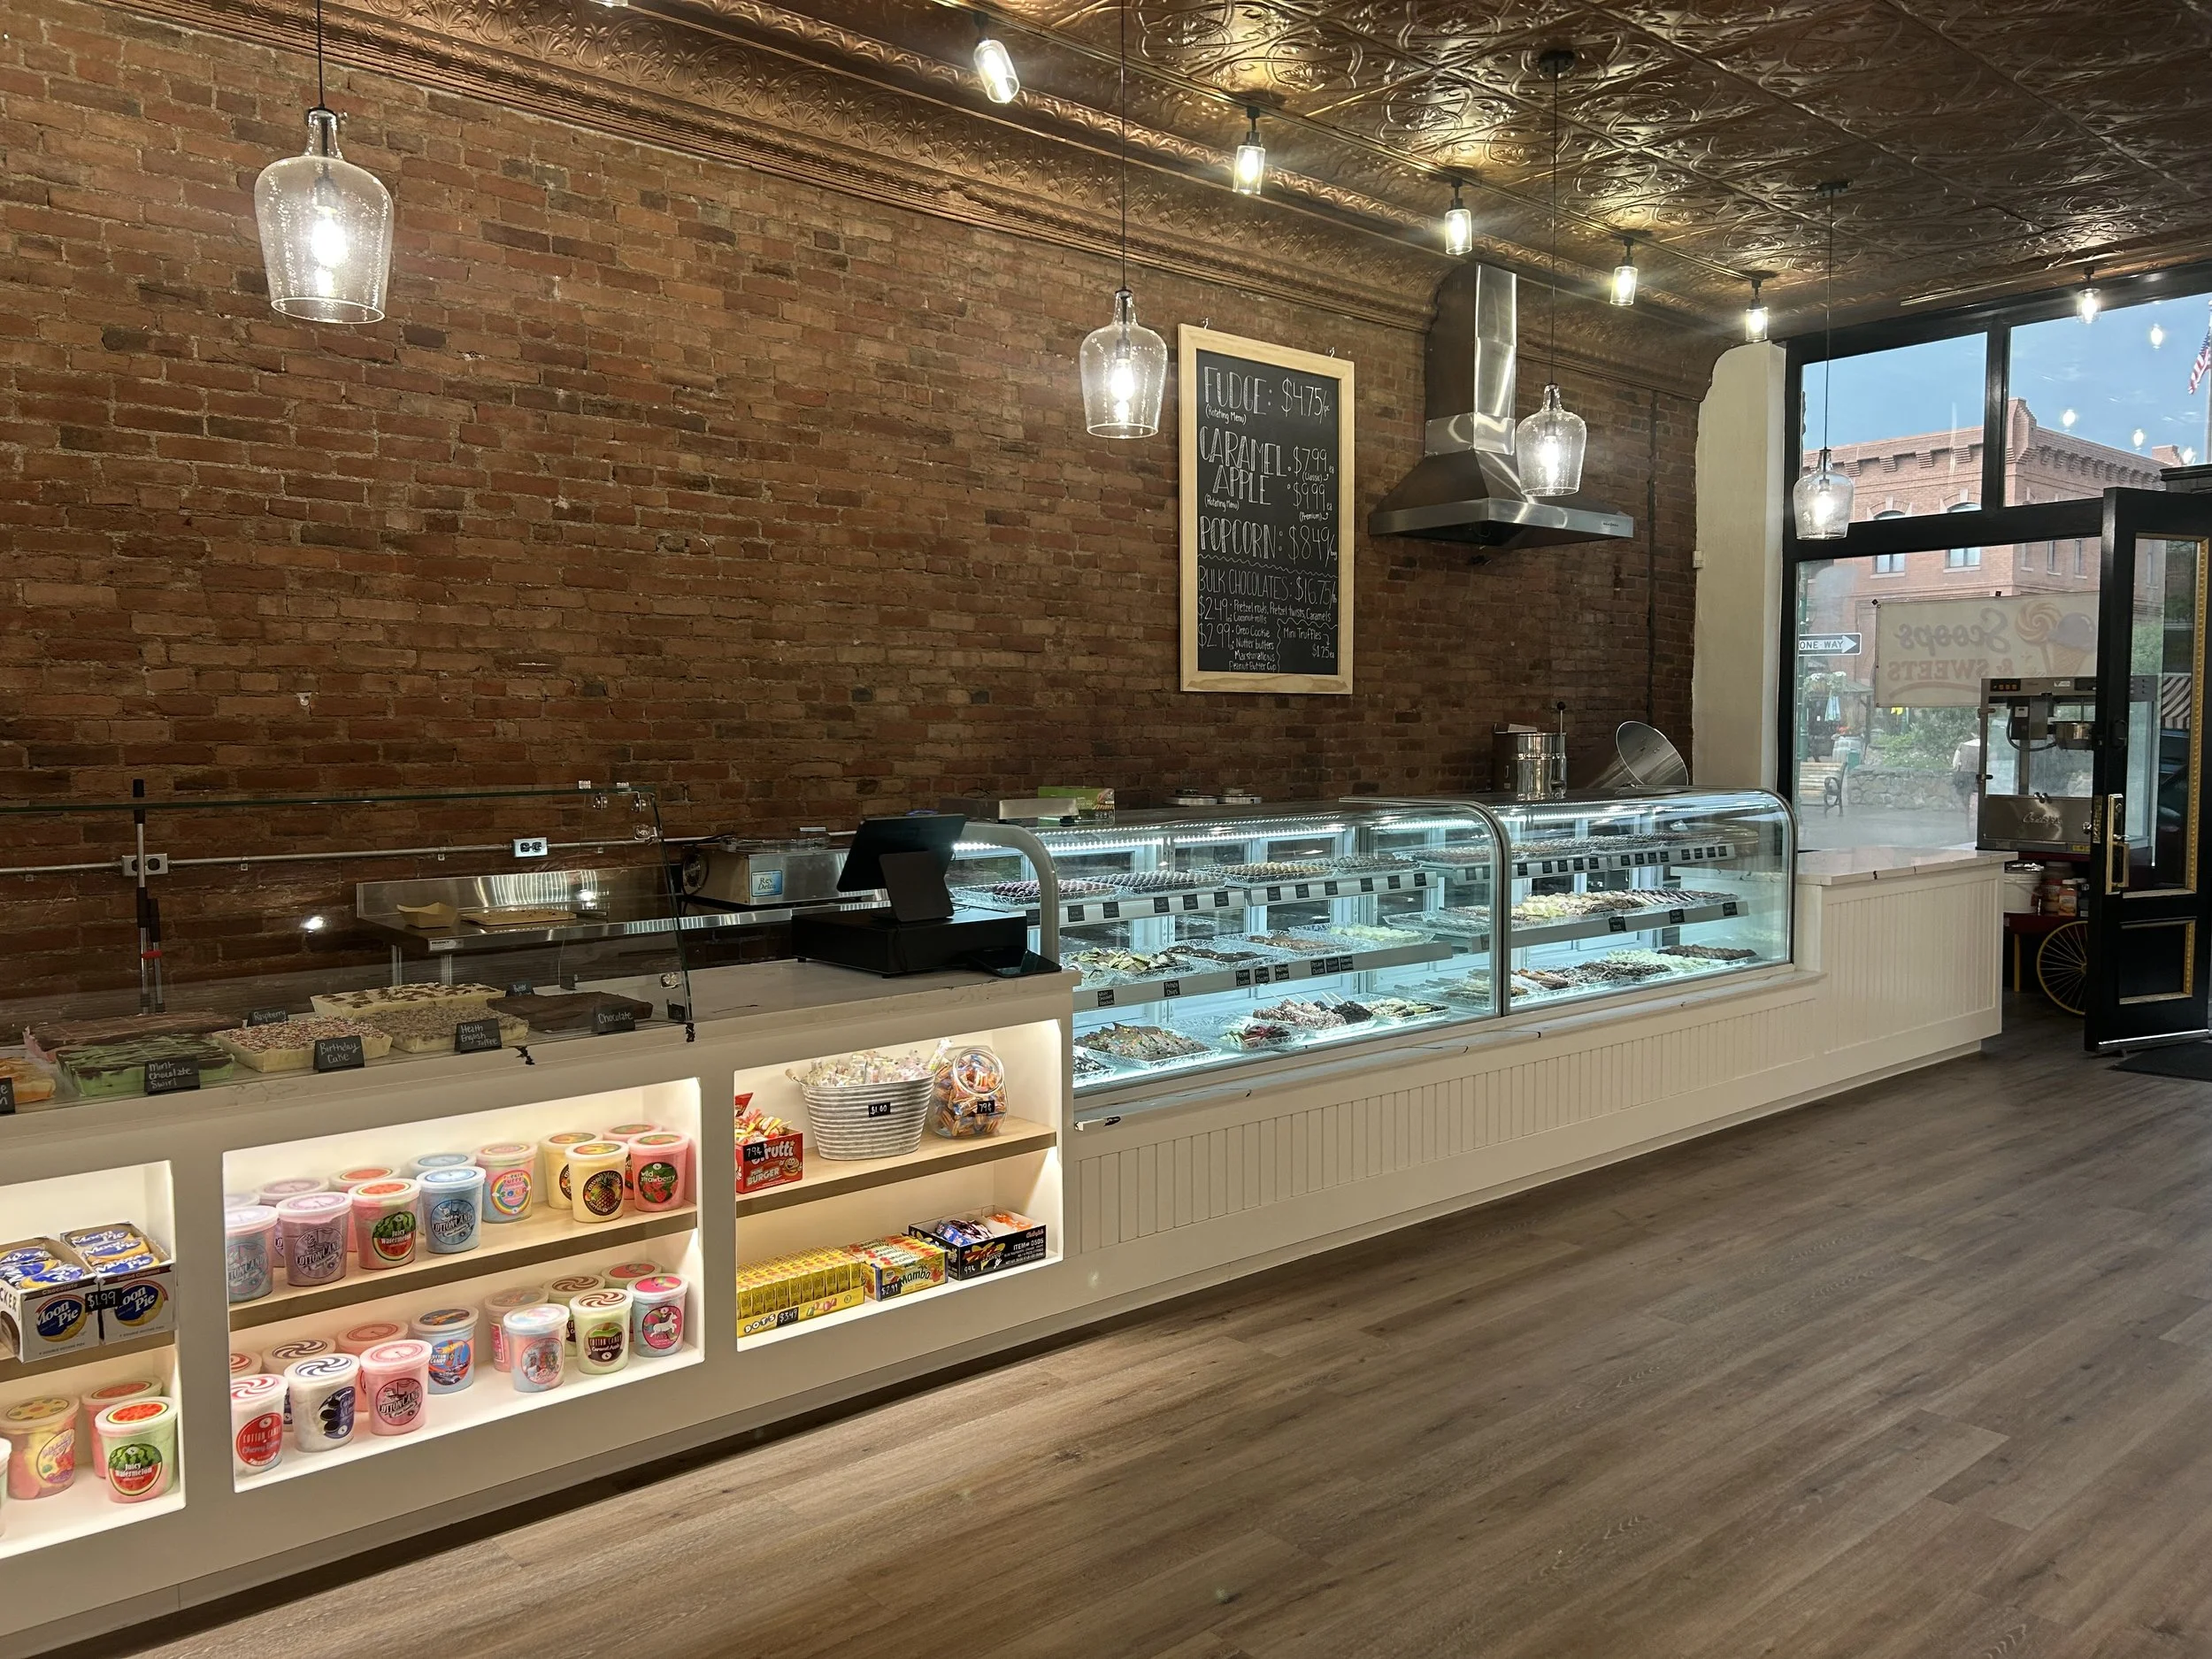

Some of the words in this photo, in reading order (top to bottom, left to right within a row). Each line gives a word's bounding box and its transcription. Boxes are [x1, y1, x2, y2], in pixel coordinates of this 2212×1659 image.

[1205, 403, 1230, 425] (Rotating
[1230, 411, 1247, 425] Menu)
[1199, 426, 1287, 476] CARAMEL
[1212, 465, 1271, 505] APPLE
[1199, 565, 1226, 594] BULK
[1233, 599, 1254, 613] Pretzel
[1270, 602, 1287, 616] Pretzel
[1306, 609, 1331, 623] Caramels
[1235, 623, 1250, 635] Oreo
[1250, 625, 1271, 638] Cookie
[1283, 627, 1296, 639] Mini
[1297, 627, 1322, 640] Truffles
[1235, 639, 1254, 649] Nutter
[1229, 662, 1248, 672] Peanut
[1249, 662, 1266, 671] Butter
[1267, 662, 1277, 672] Cup
[253, 1010, 286, 1022] Raspberry
[597, 1010, 634, 1025] Chocolate
[461, 1024, 484, 1033] Heath
[461, 1032, 486, 1044] English
[319, 1042, 361, 1055] Birthday
[327, 1054, 350, 1064] Cake
[150, 1079, 177, 1089] Swirl
[641, 1175, 676, 1184] strawberry
[747, 1167, 780, 1187] BURGER
[899, 1271, 931, 1286] Mamba
[42, 1283, 78, 1294] Chocolate
[88, 1291, 116, 1309] $1.99
[134, 1294, 155, 1312] Pie
[35, 1302, 70, 1325] Moon
[58, 1309, 79, 1327] Pie
[744, 1314, 776, 1333] DOTS
[115, 1467, 153, 1478] Watermelon
